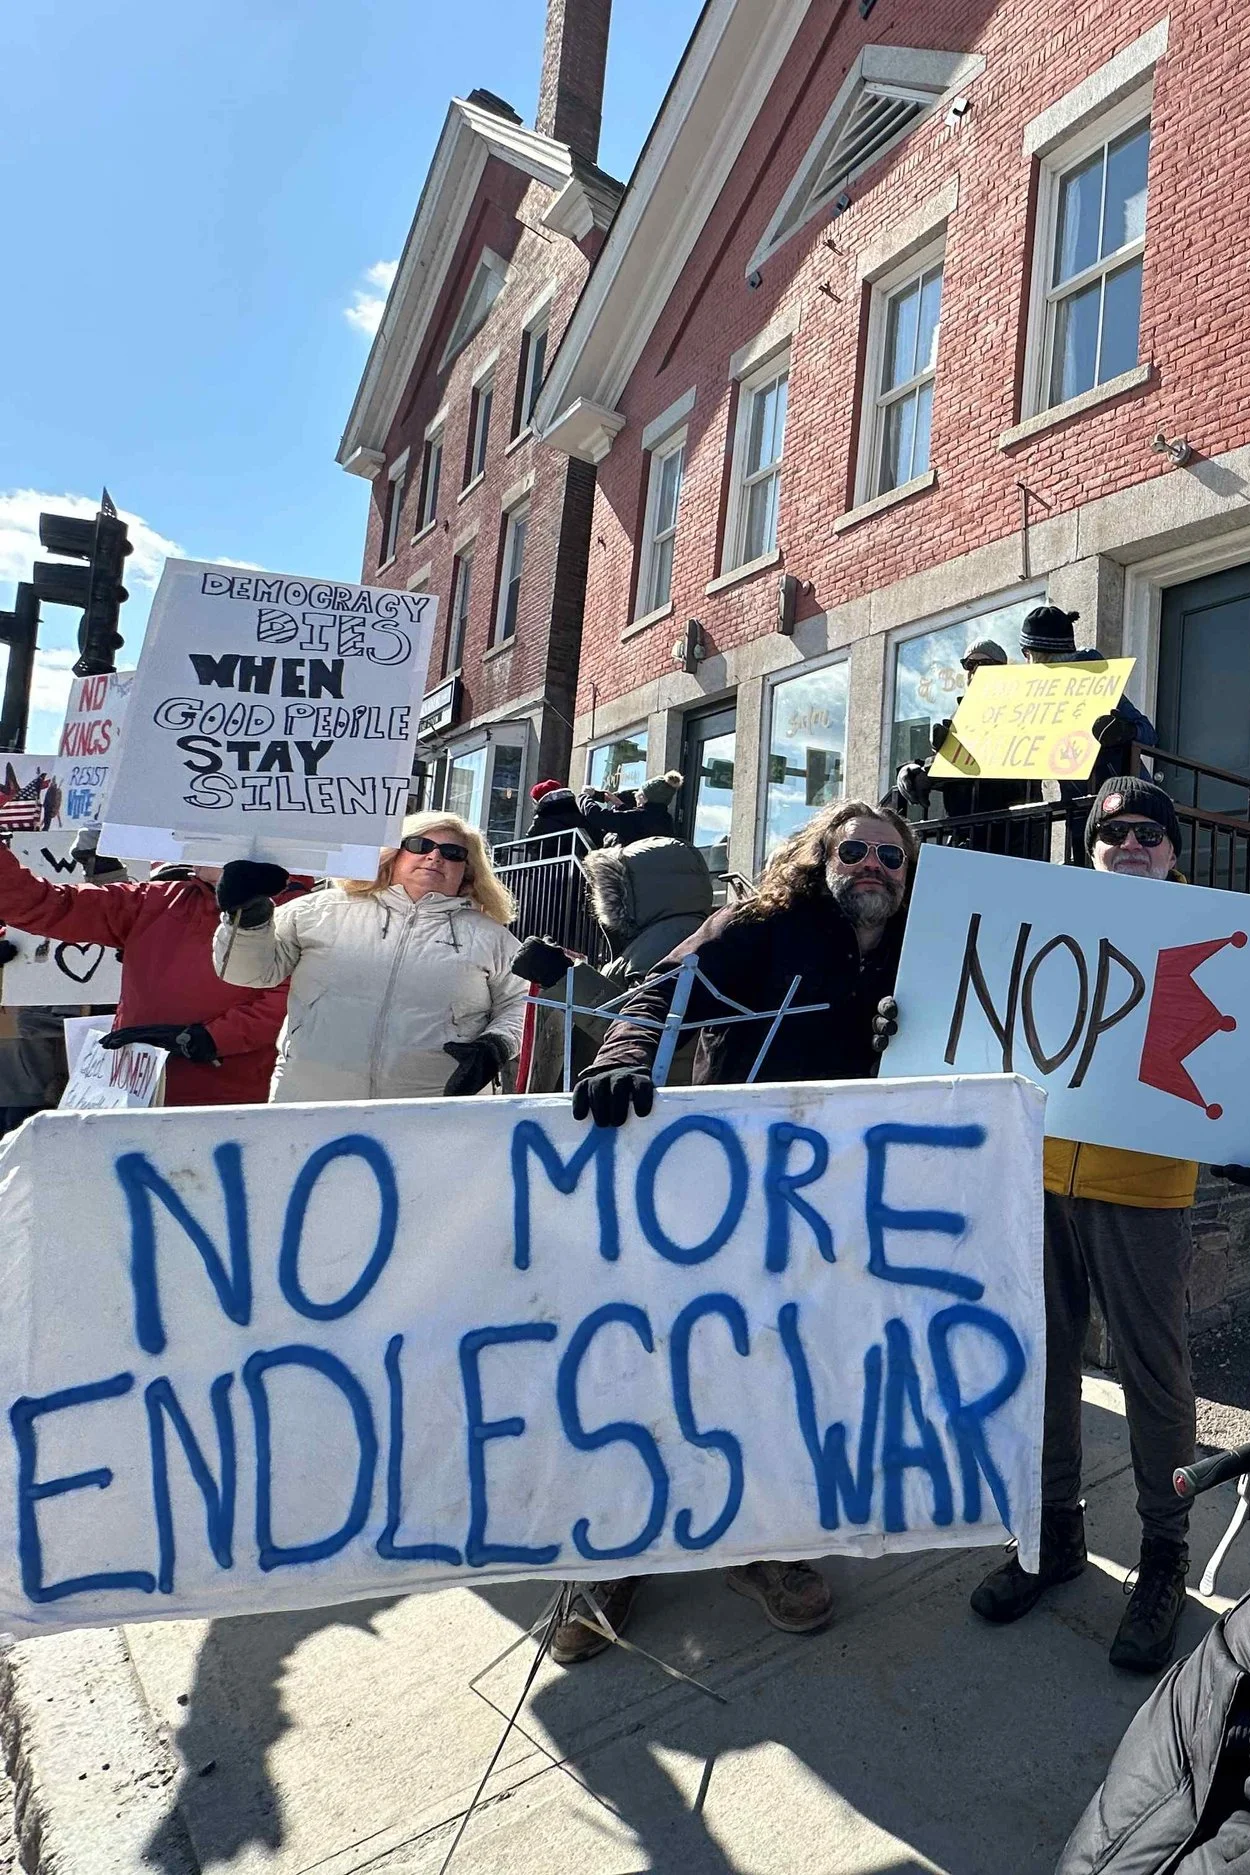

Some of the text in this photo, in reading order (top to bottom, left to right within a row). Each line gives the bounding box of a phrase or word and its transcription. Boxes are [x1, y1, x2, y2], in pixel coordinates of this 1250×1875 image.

[201, 572, 430, 622] DEMOCRACY
[257, 608, 411, 665] DIES
[78, 675, 109, 712] NO
[189, 653, 345, 699] WHEN
[1026, 679, 1061, 697] THE
[1064, 675, 1121, 697] REIGN
[154, 697, 275, 736] GOOD
[284, 702, 411, 741] PEOPLE
[982, 704, 1009, 725] OF
[1013, 701, 1067, 725] SPITE
[59, 719, 113, 757] KINGS
[176, 735, 334, 776] STAY
[69, 766, 109, 787] RESIST
[183, 772, 411, 816] SILENT
[109, 1049, 158, 1100] WOMEN
[112, 1112, 988, 1357] NO MORE
[8, 1289, 1029, 1604] ENDLESS WAR
